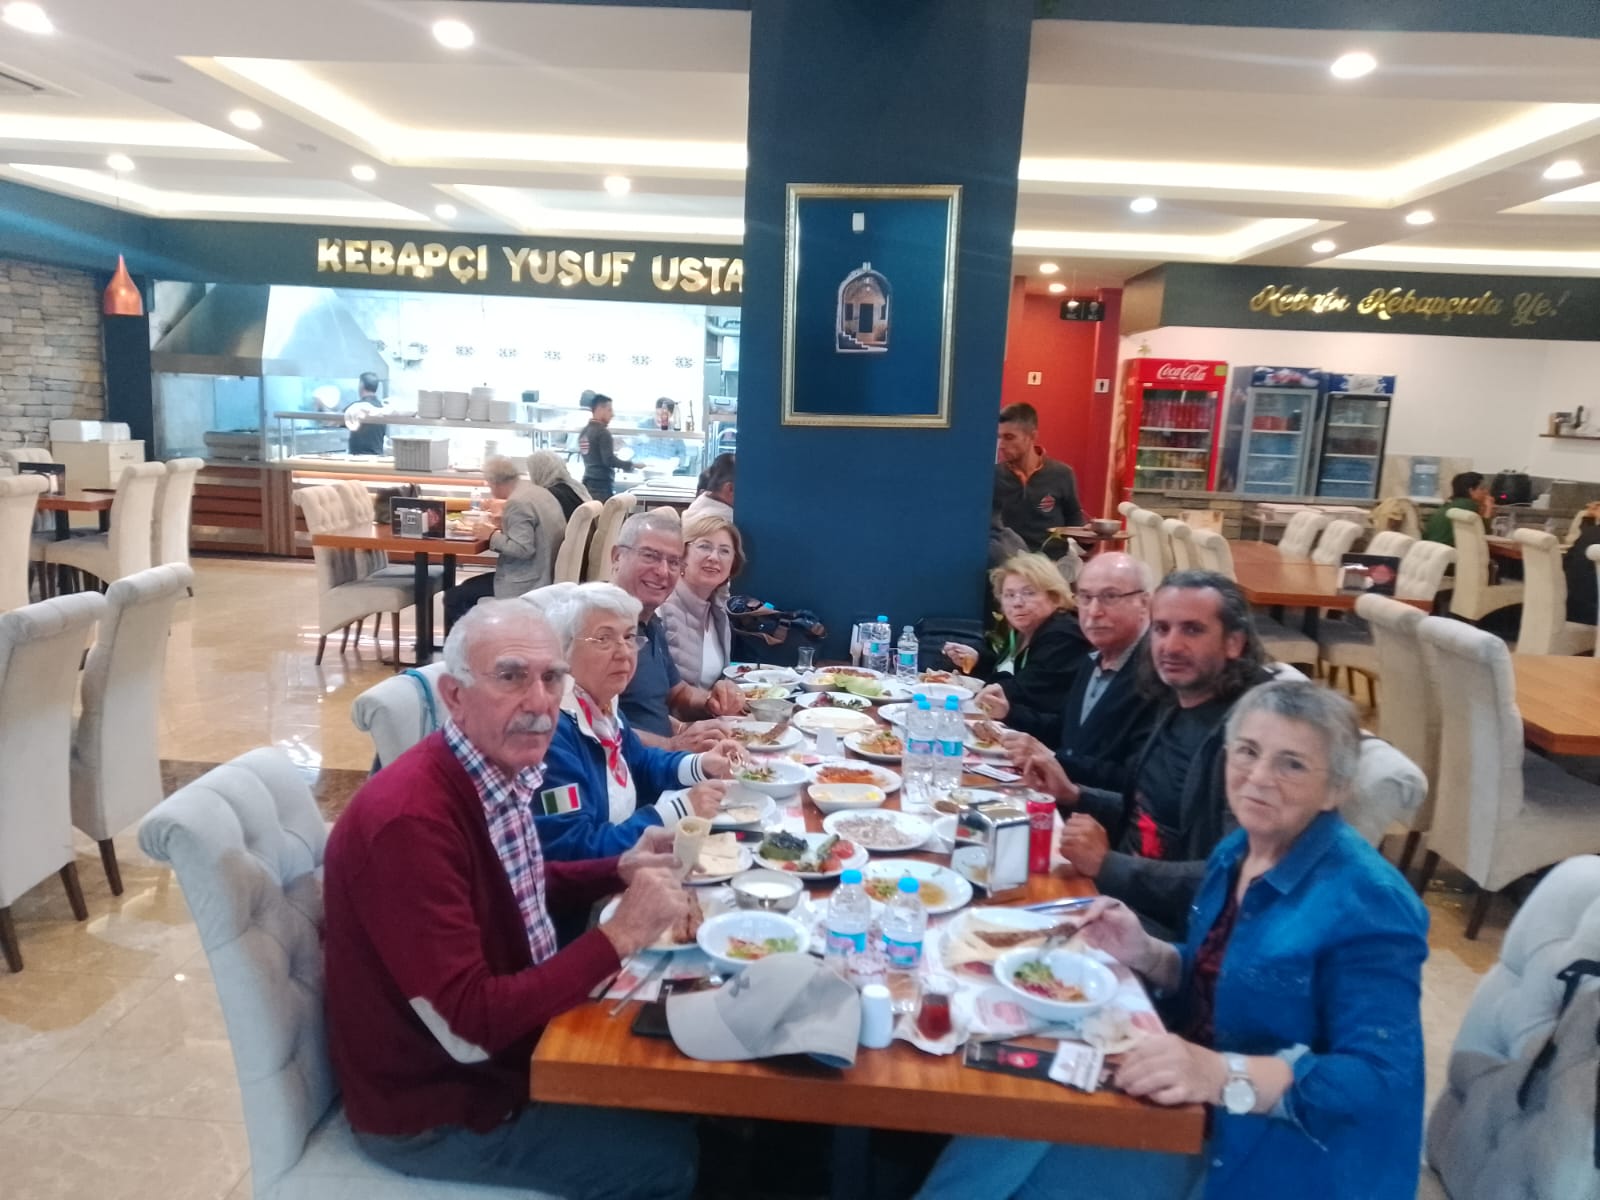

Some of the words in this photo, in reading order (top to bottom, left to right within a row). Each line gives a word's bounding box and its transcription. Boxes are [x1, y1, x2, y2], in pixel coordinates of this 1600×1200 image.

[317, 237, 488, 284] KEBAPÇI
[502, 246, 636, 287] YUSUF
[651, 254, 744, 295] USTA
[1511, 289, 1571, 327] Ye!
